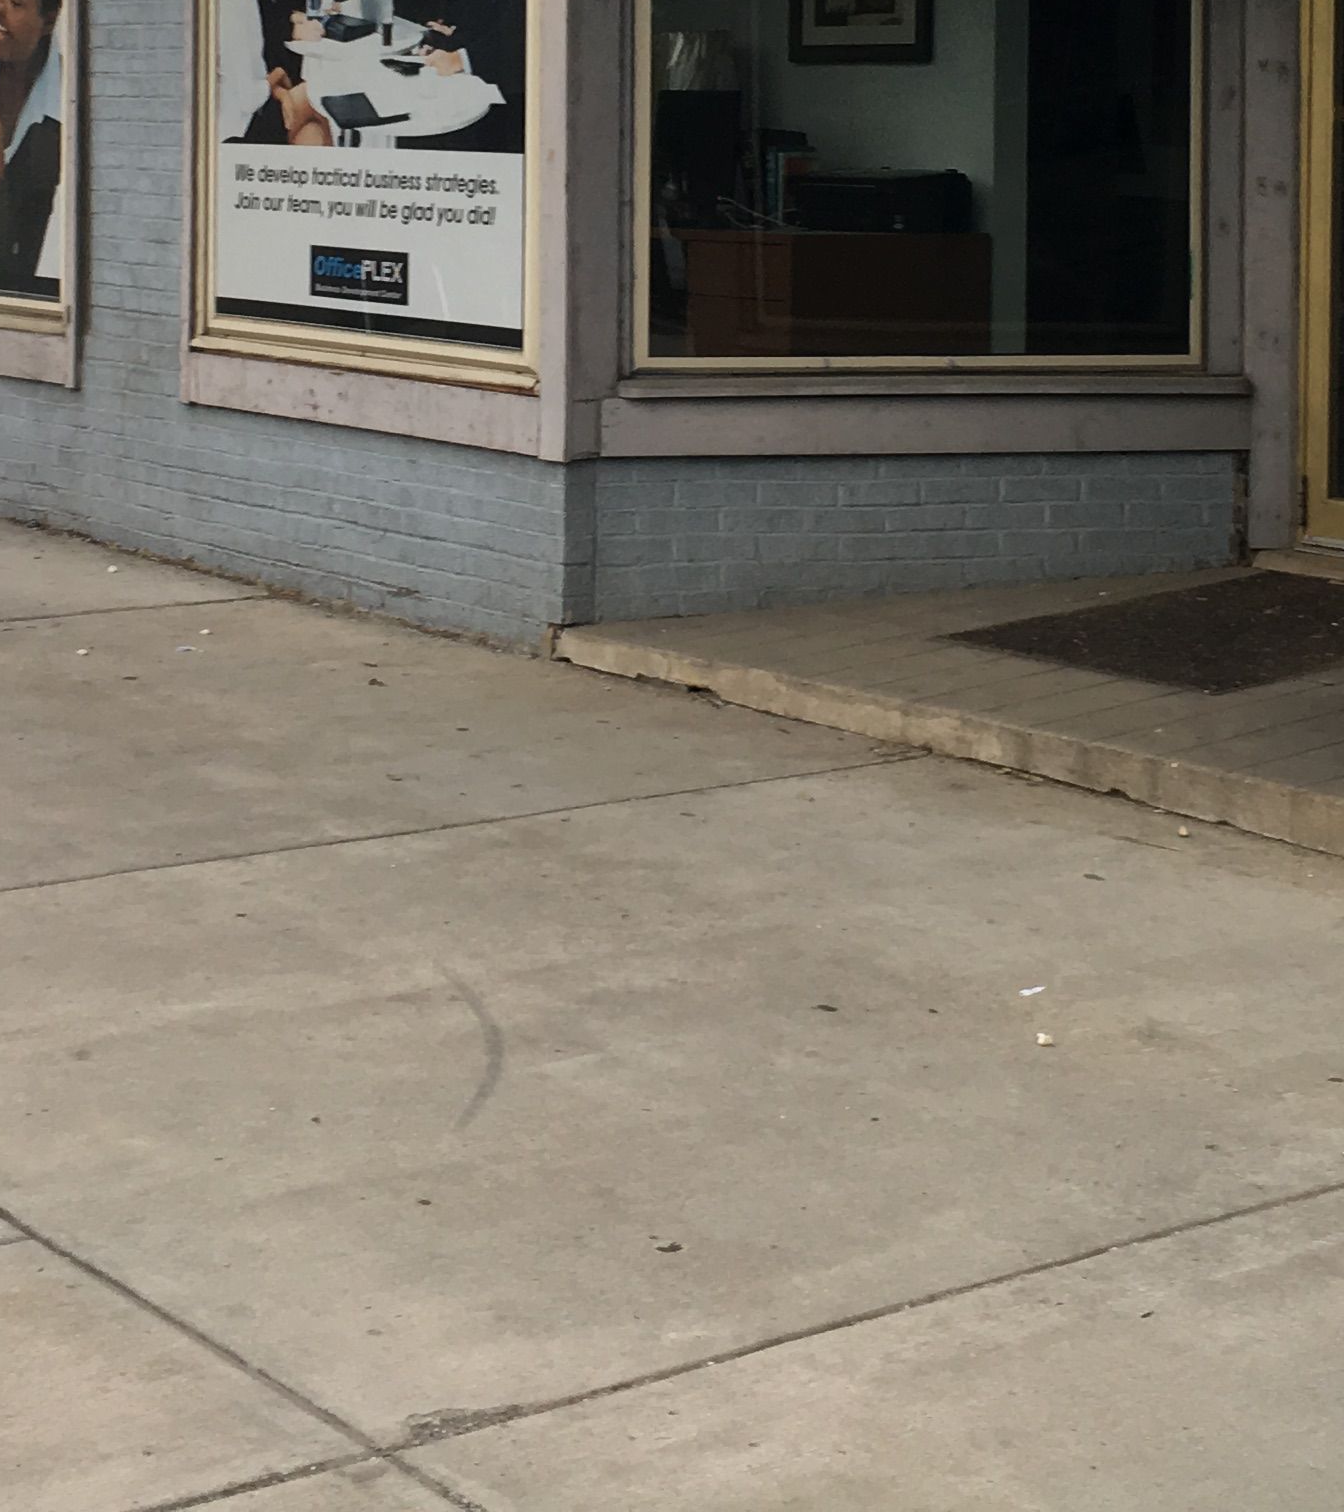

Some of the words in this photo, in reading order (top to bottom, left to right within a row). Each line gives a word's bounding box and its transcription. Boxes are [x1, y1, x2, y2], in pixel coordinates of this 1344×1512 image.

[234, 163, 255, 182] We
[257, 165, 309, 188] develop
[312, 167, 360, 186] tactical
[363, 169, 421, 191] business
[424, 173, 500, 197] strategies.
[234, 192, 260, 210] Join
[262, 196, 283, 211] our
[287, 194, 325, 218] team,
[327, 199, 353, 219] you
[355, 199, 376, 218] will
[379, 200, 397, 219] be
[400, 201, 435, 224] glad
[436, 207, 463, 226] you
[466, 205, 497, 226] did!
[313, 255, 404, 284] OfficePLEX
